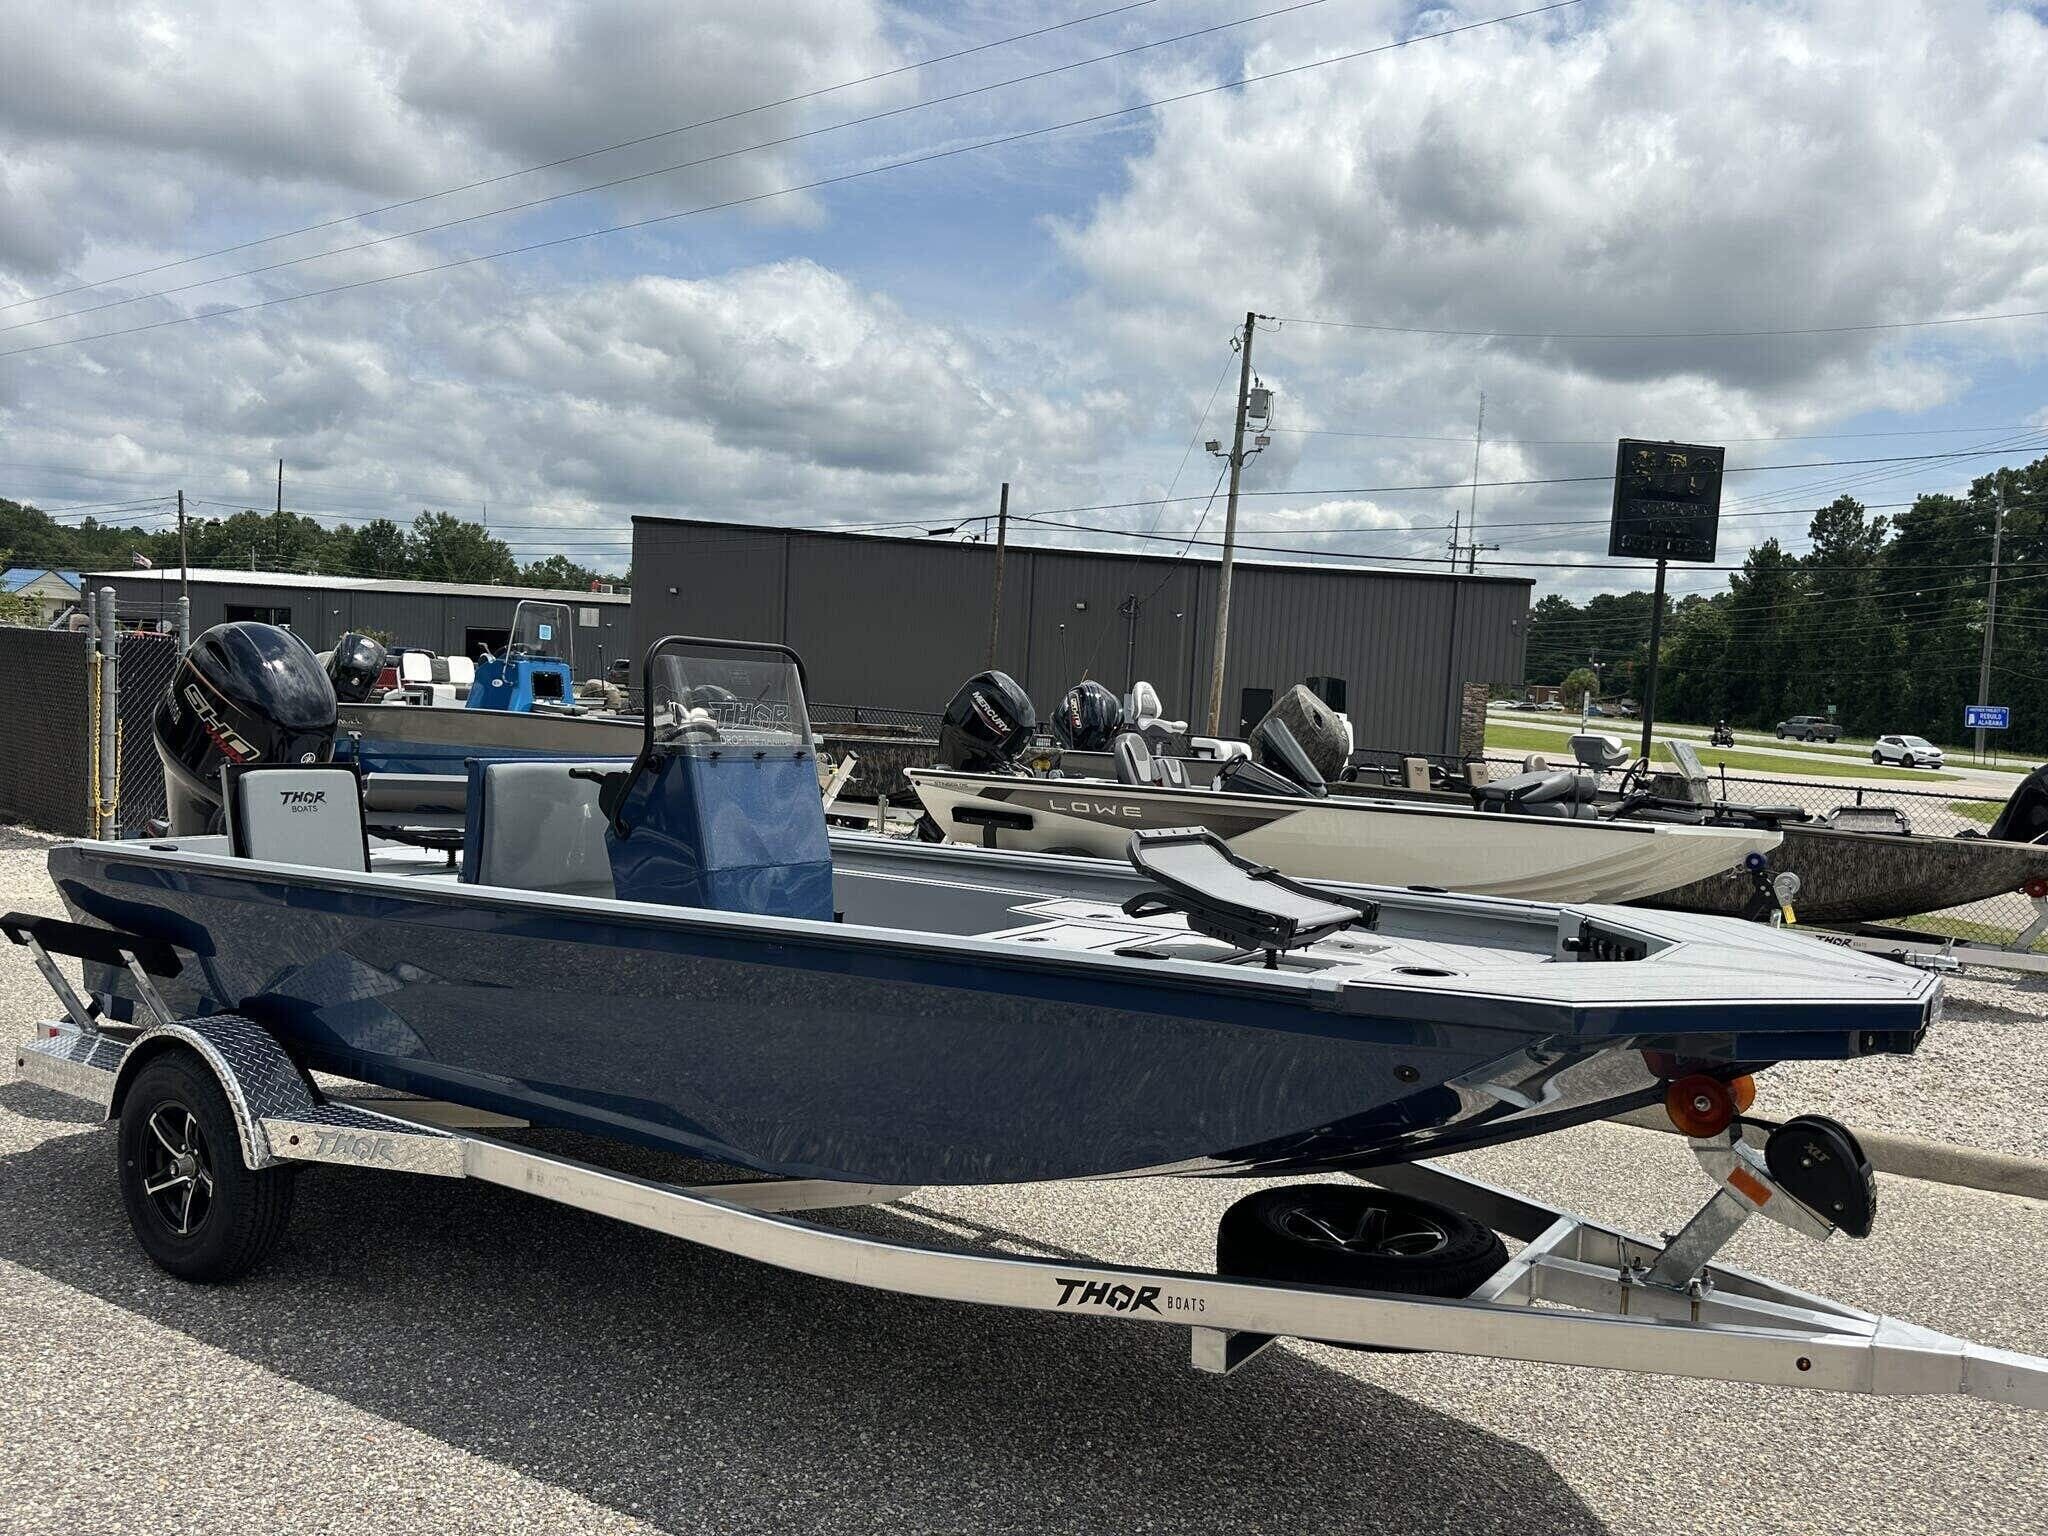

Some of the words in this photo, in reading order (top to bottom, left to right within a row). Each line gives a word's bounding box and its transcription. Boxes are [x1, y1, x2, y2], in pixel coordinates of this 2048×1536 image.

[709, 701, 793, 732] THOR
[972, 691, 1011, 733] MERCURY
[280, 791, 327, 805] THOR
[1049, 800, 1142, 817] LOWE
[1816, 935, 1852, 948] THOR
[315, 1130, 395, 1162] THOR
[1804, 1142, 1830, 1161] XLT
[1055, 1278, 1163, 1315] THOR
[1167, 1296, 1205, 1312] BOATS
